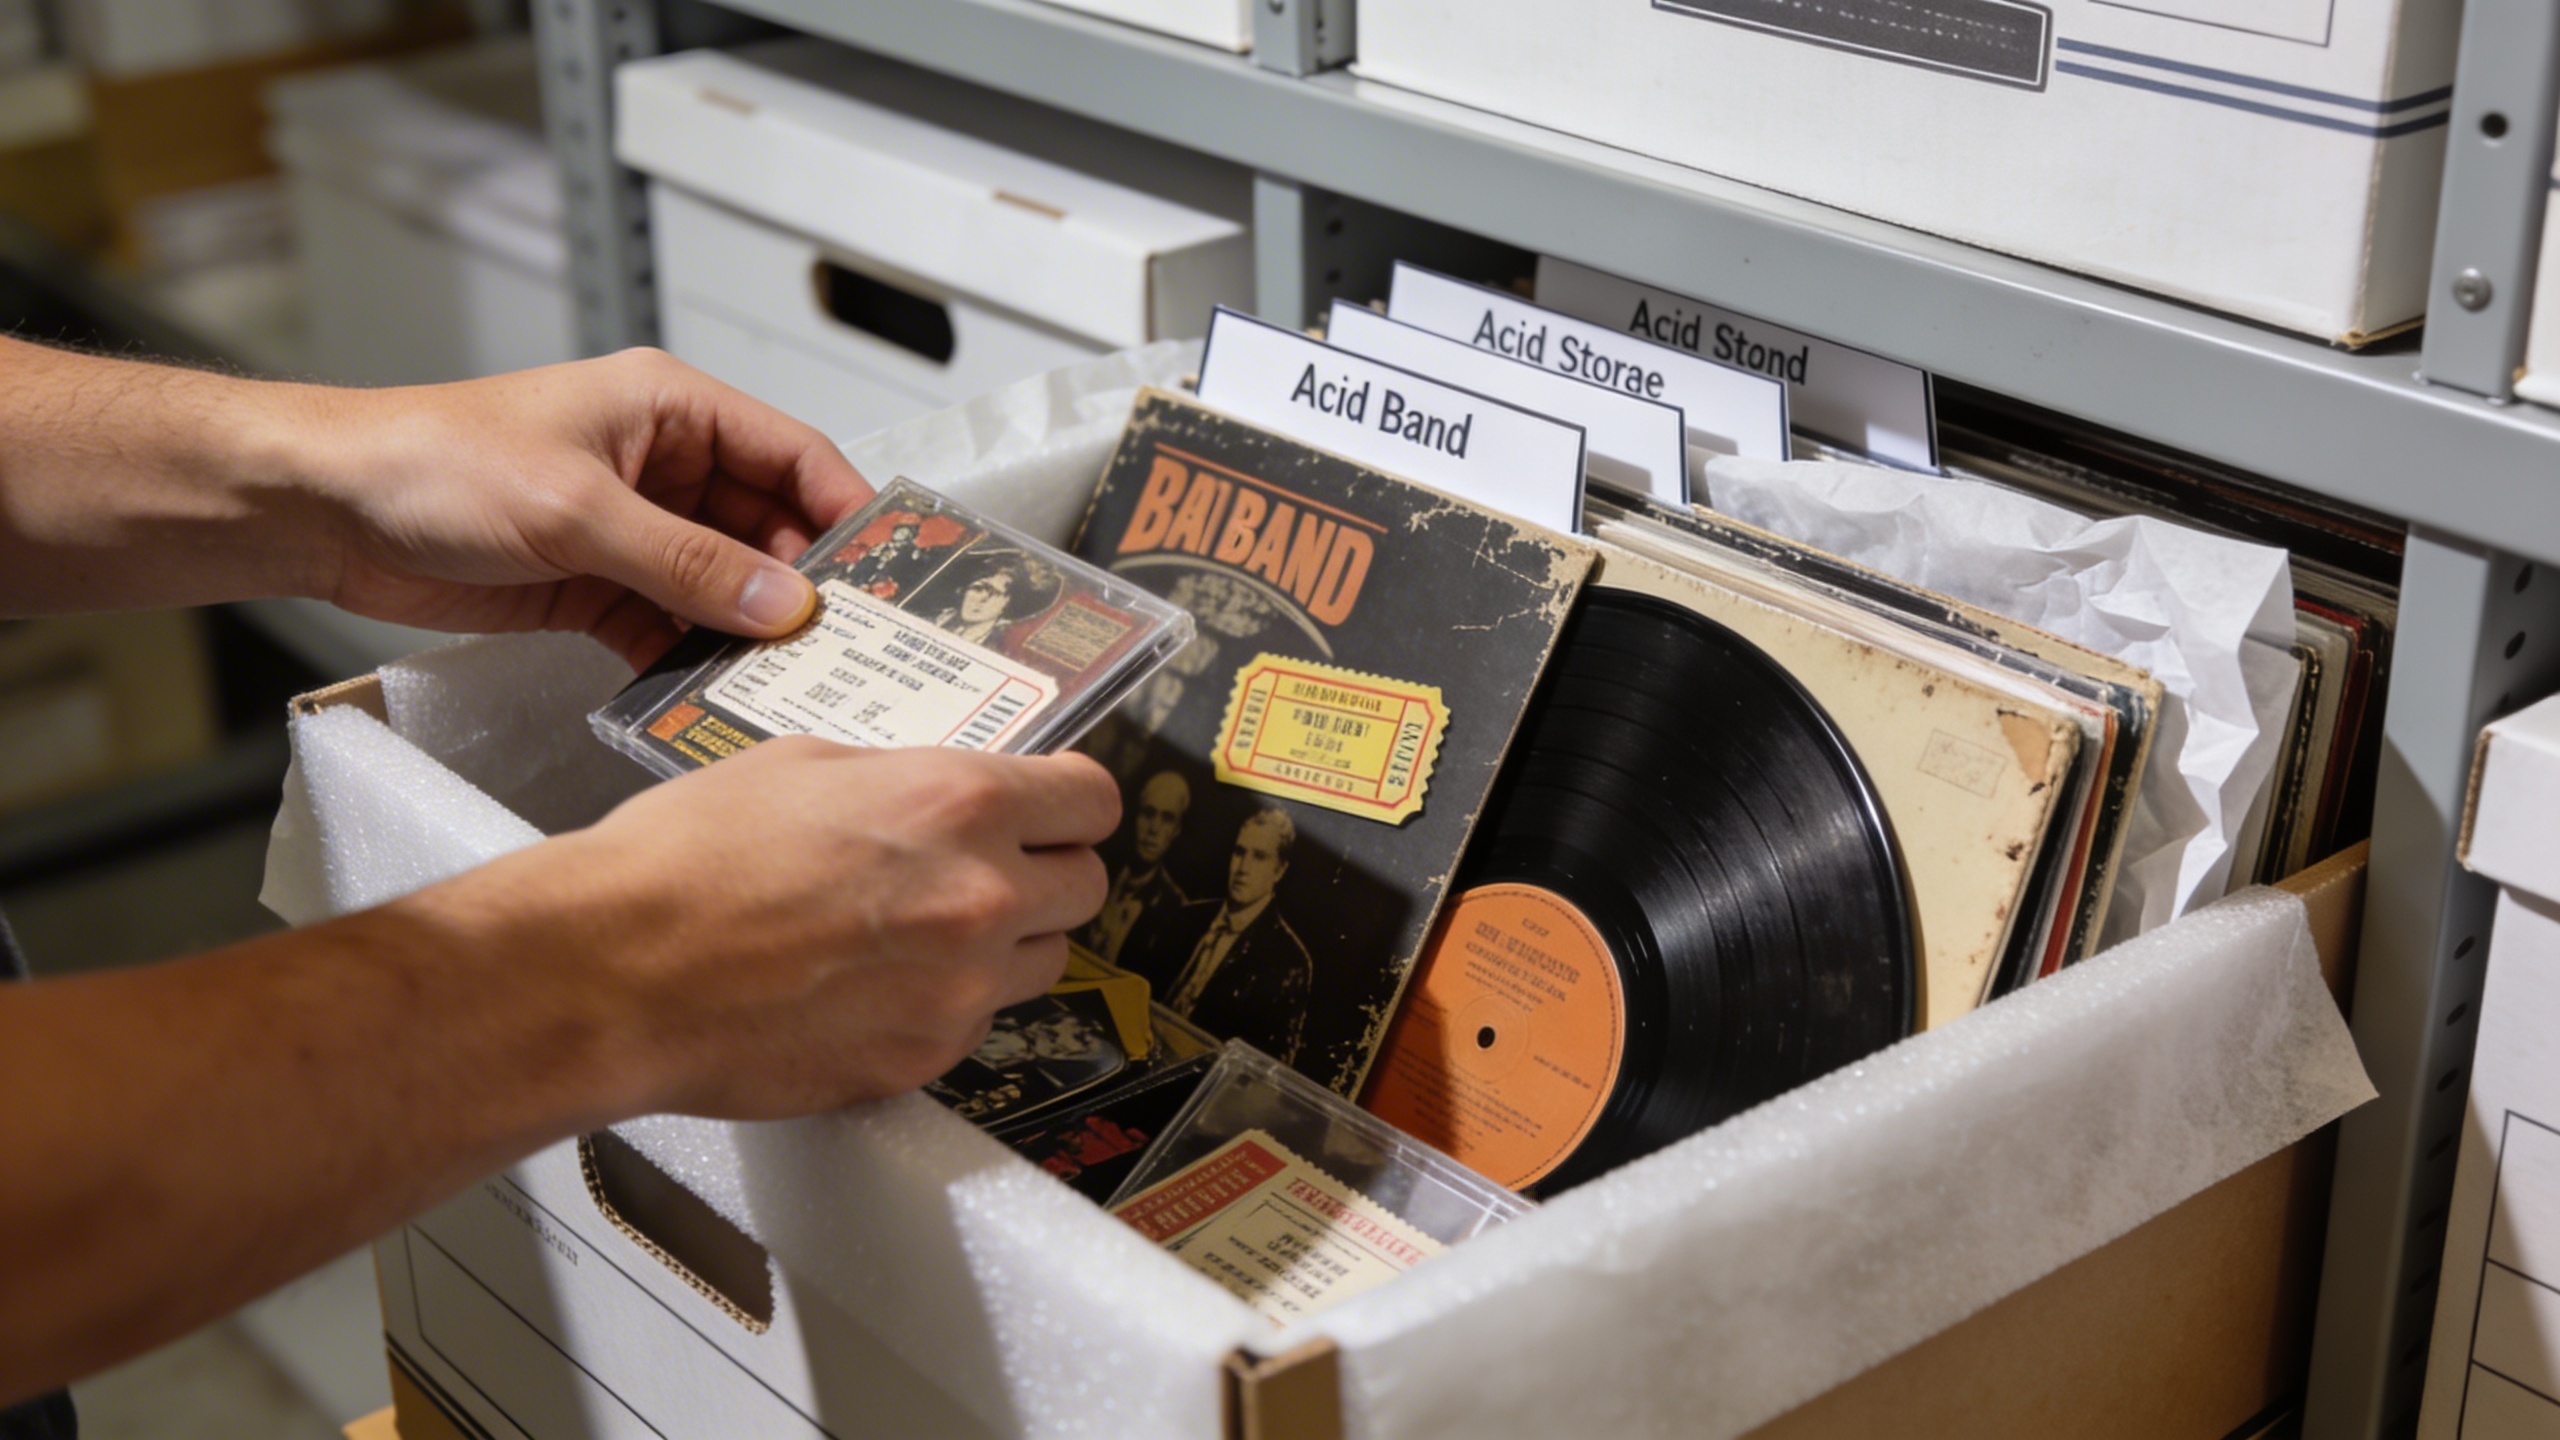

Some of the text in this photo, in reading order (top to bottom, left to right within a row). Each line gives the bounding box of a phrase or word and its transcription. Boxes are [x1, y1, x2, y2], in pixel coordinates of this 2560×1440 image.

[1472, 308, 1665, 400] Acid Storae
[1629, 297, 1809, 386] Acid Stond
[1290, 361, 1474, 460] Acid Band
